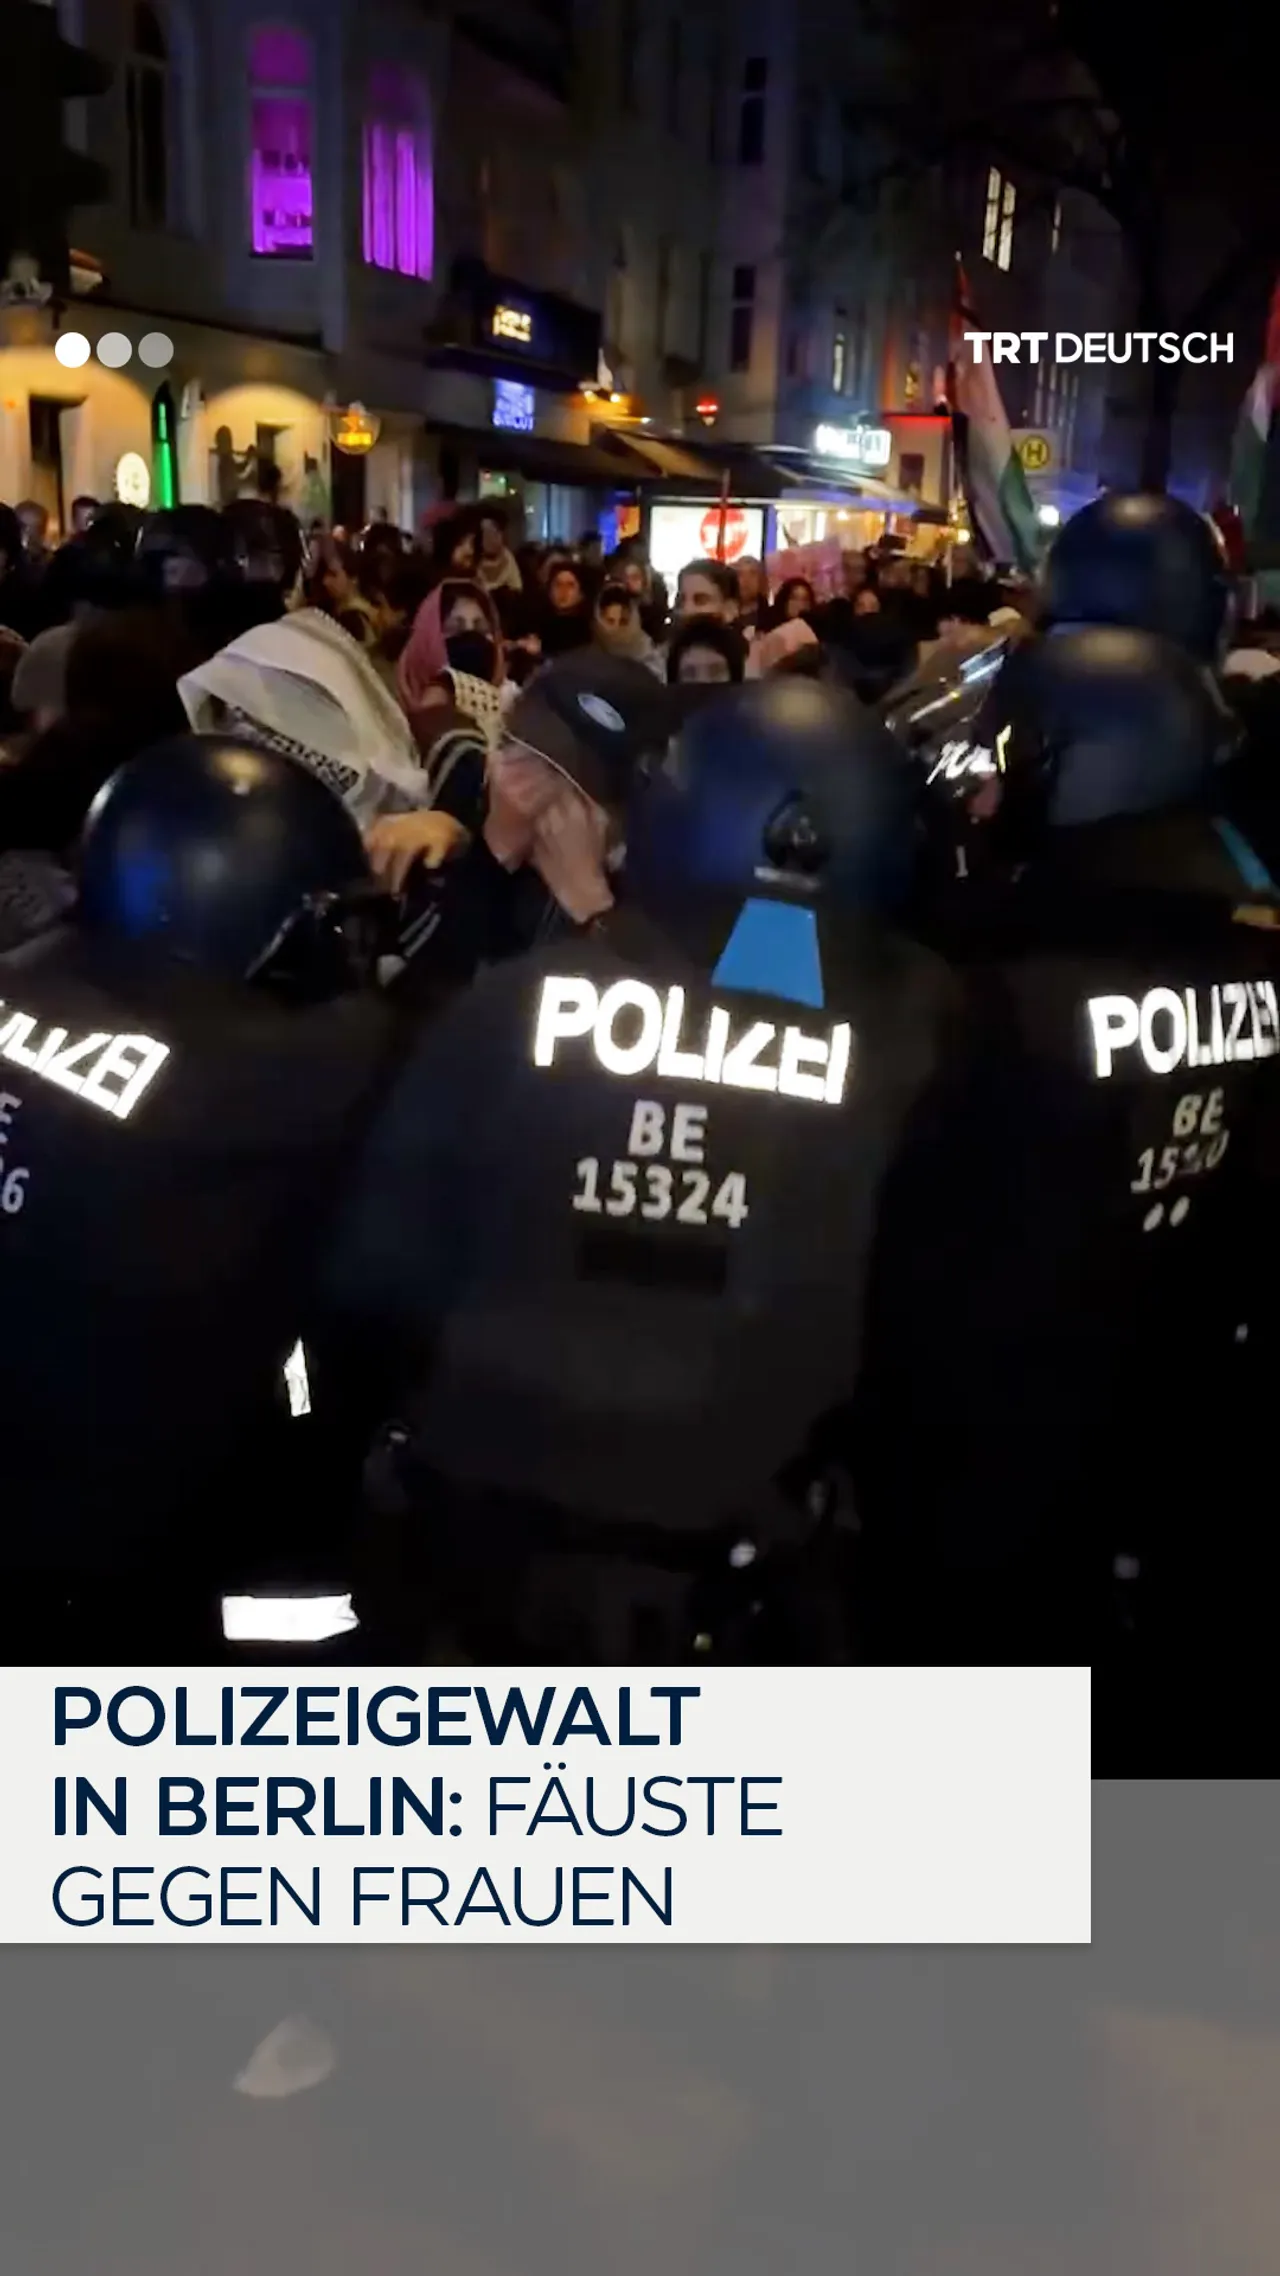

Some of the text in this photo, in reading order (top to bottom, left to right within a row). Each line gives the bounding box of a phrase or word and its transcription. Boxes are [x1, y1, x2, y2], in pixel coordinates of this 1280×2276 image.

[535, 976, 850, 1104] POLIZEI
[1088, 980, 1279, 1078] POLIZEI
[628, 1099, 708, 1162] BE
[1172, 1086, 1225, 1137] BE
[572, 1156, 749, 1228] 15324
